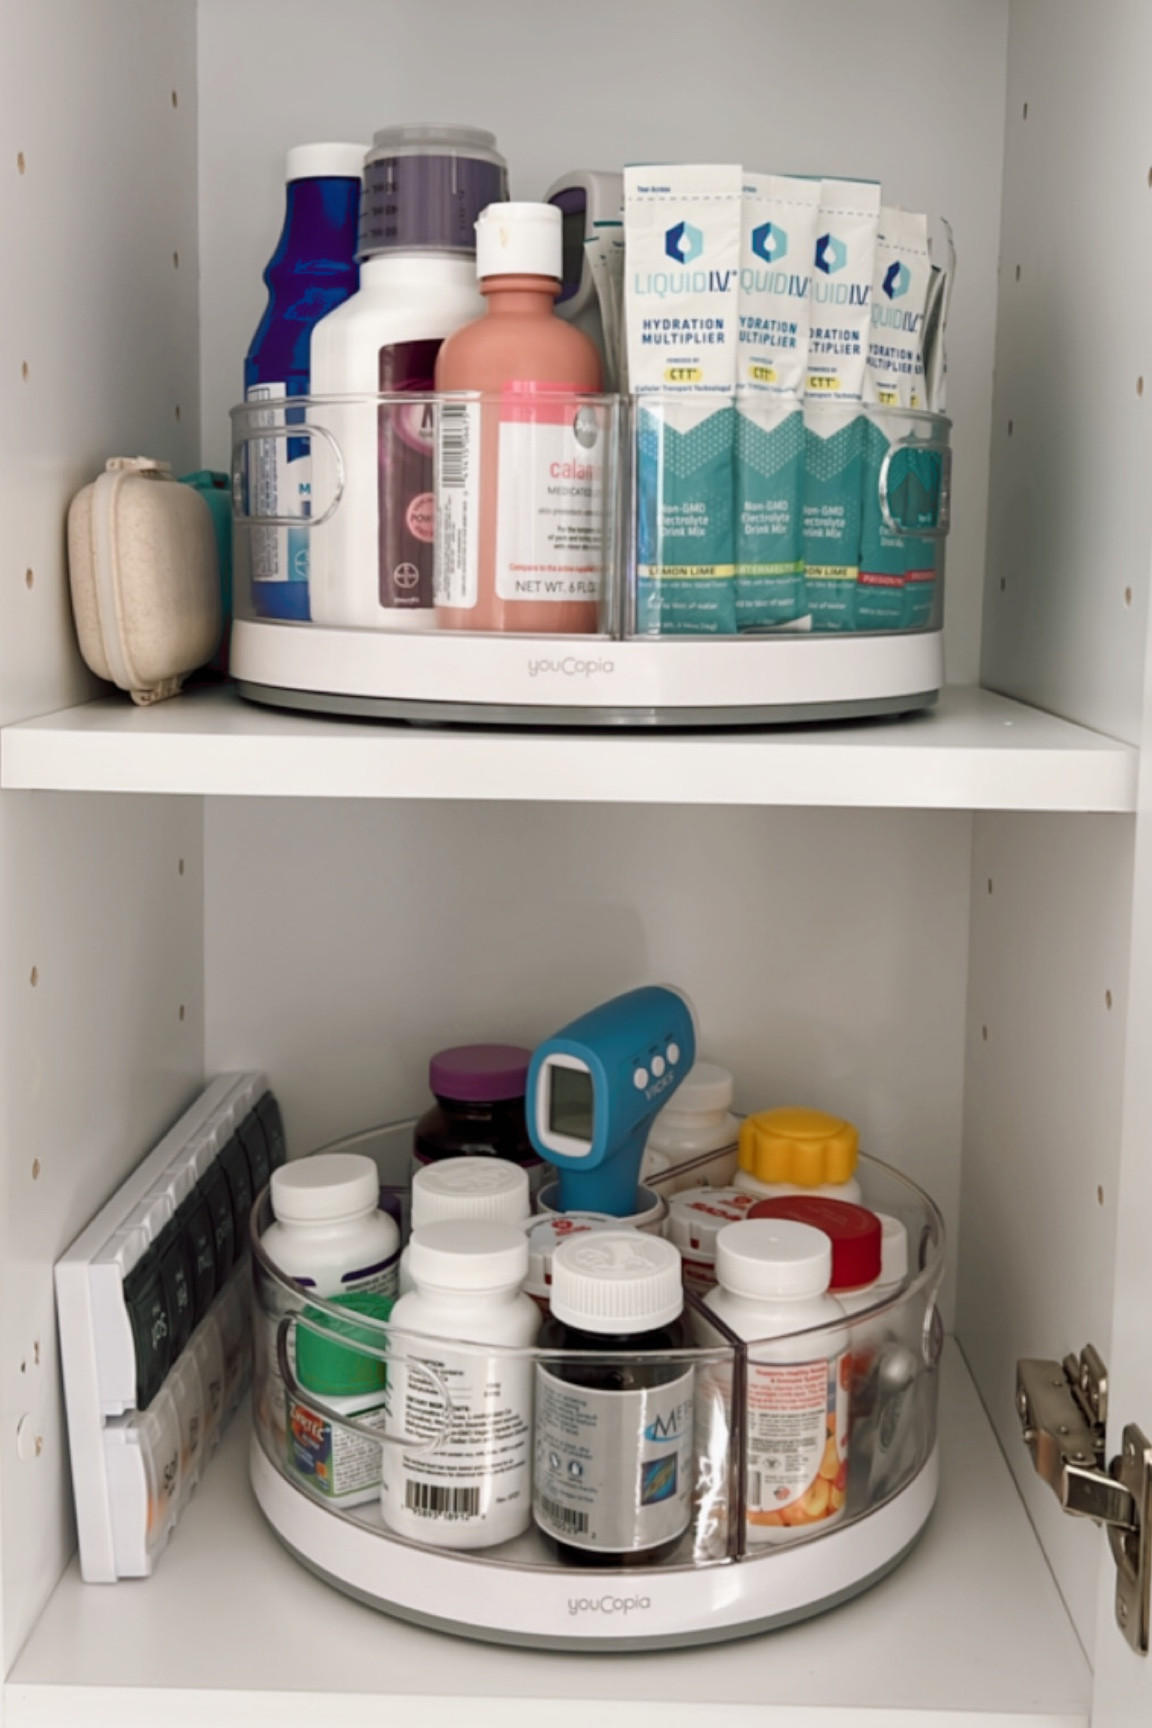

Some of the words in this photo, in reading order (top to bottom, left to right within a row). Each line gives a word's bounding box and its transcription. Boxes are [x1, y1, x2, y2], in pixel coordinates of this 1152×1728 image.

[643, 318, 724, 331] HYDRATION
[739, 316, 797, 335] YDRATION
[642, 332, 725, 345] MULTIPLIER
[739, 330, 796, 348] ULTIPLIER
[810, 341, 861, 355] TIPLIER
[744, 501, 788, 511] Non-GMO
[741, 512, 790, 523] Electrolyte
[688, 527, 705, 536] Mix
[744, 524, 768, 534] Drink
[771, 525, 786, 534] Mix
[690, 565, 715, 575] LIME
[824, 566, 847, 576] LIME
[515, 581, 541, 592] NET
[528, 657, 615, 677] youCopia
[568, 1594, 651, 1616] youCopia
